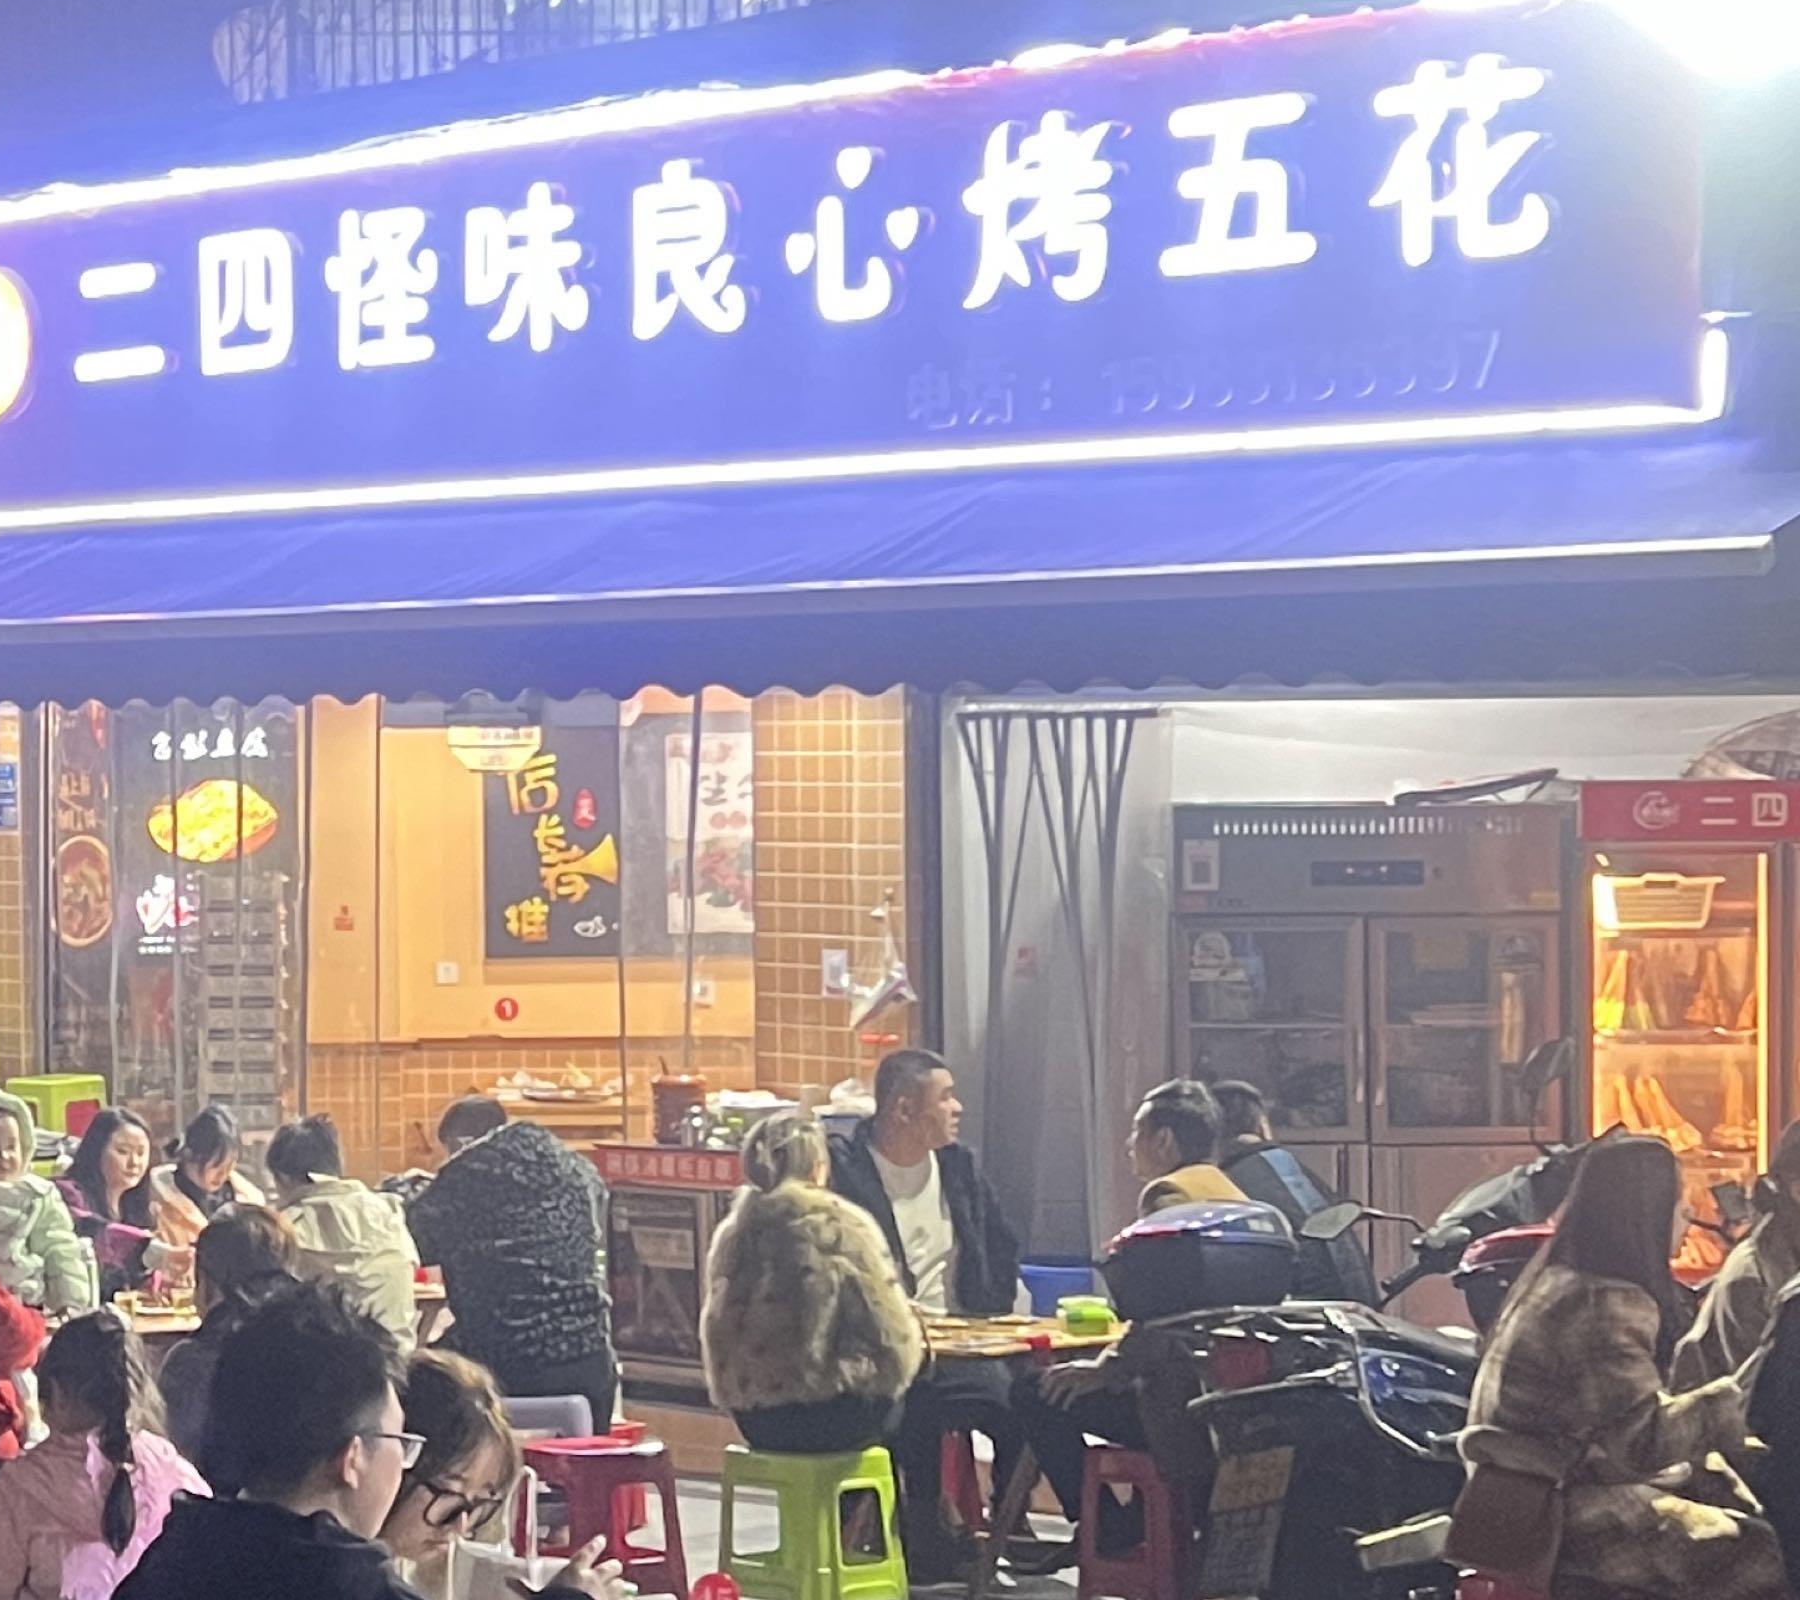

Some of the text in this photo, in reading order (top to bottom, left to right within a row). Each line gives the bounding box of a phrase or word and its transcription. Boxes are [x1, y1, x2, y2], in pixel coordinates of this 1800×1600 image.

[73, 52, 1551, 383] 二四怪味良心烤五花
